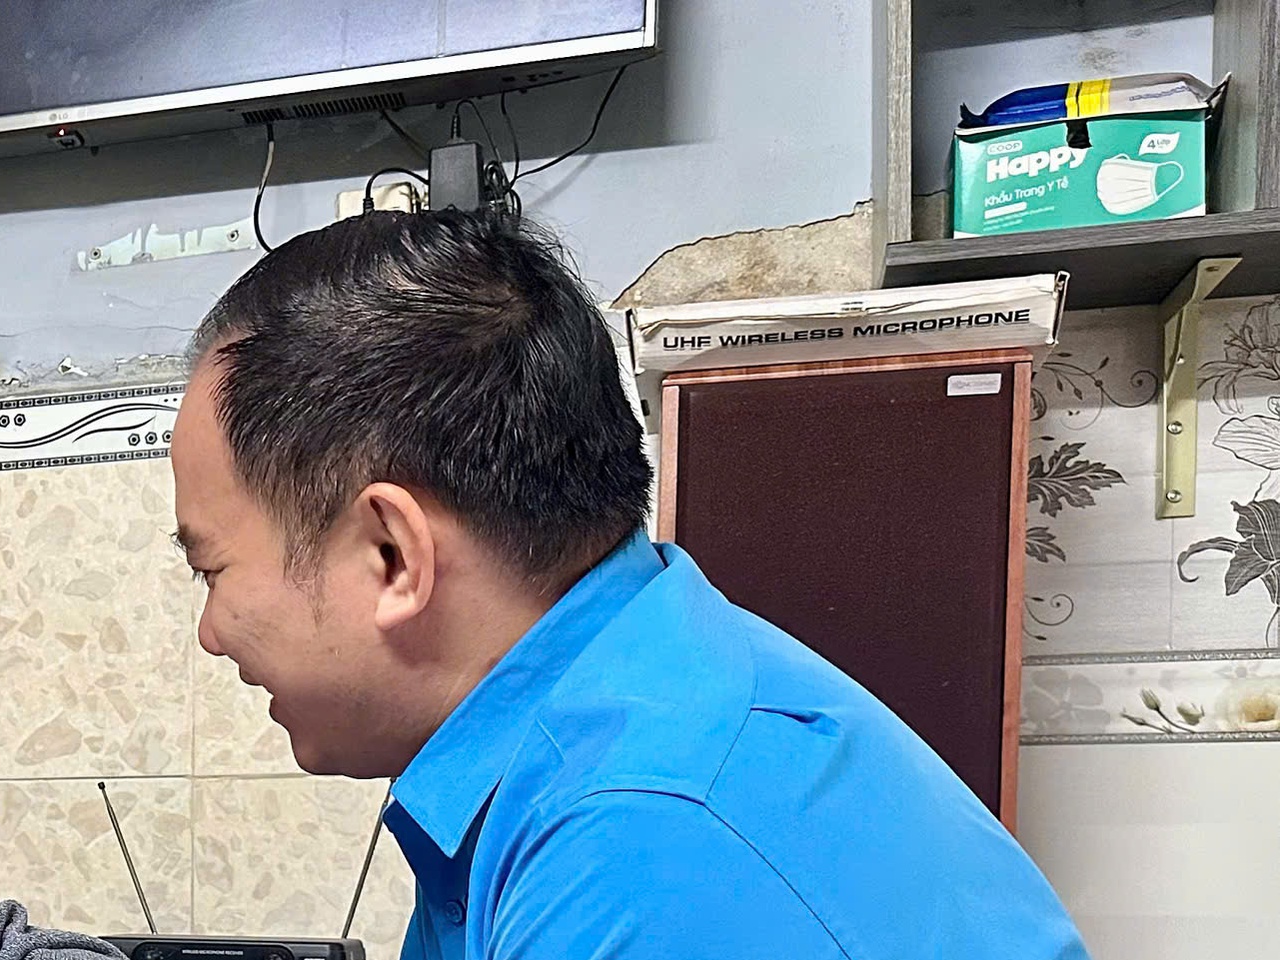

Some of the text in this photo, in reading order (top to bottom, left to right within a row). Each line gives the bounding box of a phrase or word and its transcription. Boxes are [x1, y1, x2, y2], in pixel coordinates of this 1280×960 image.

[1147, 139, 1156, 149] 4
[986, 145, 1088, 183] Happy
[984, 176, 1069, 207] Khẩu Trang Y Tế
[662, 309, 1031, 350] UHF WIRELESS MICROPHONE
